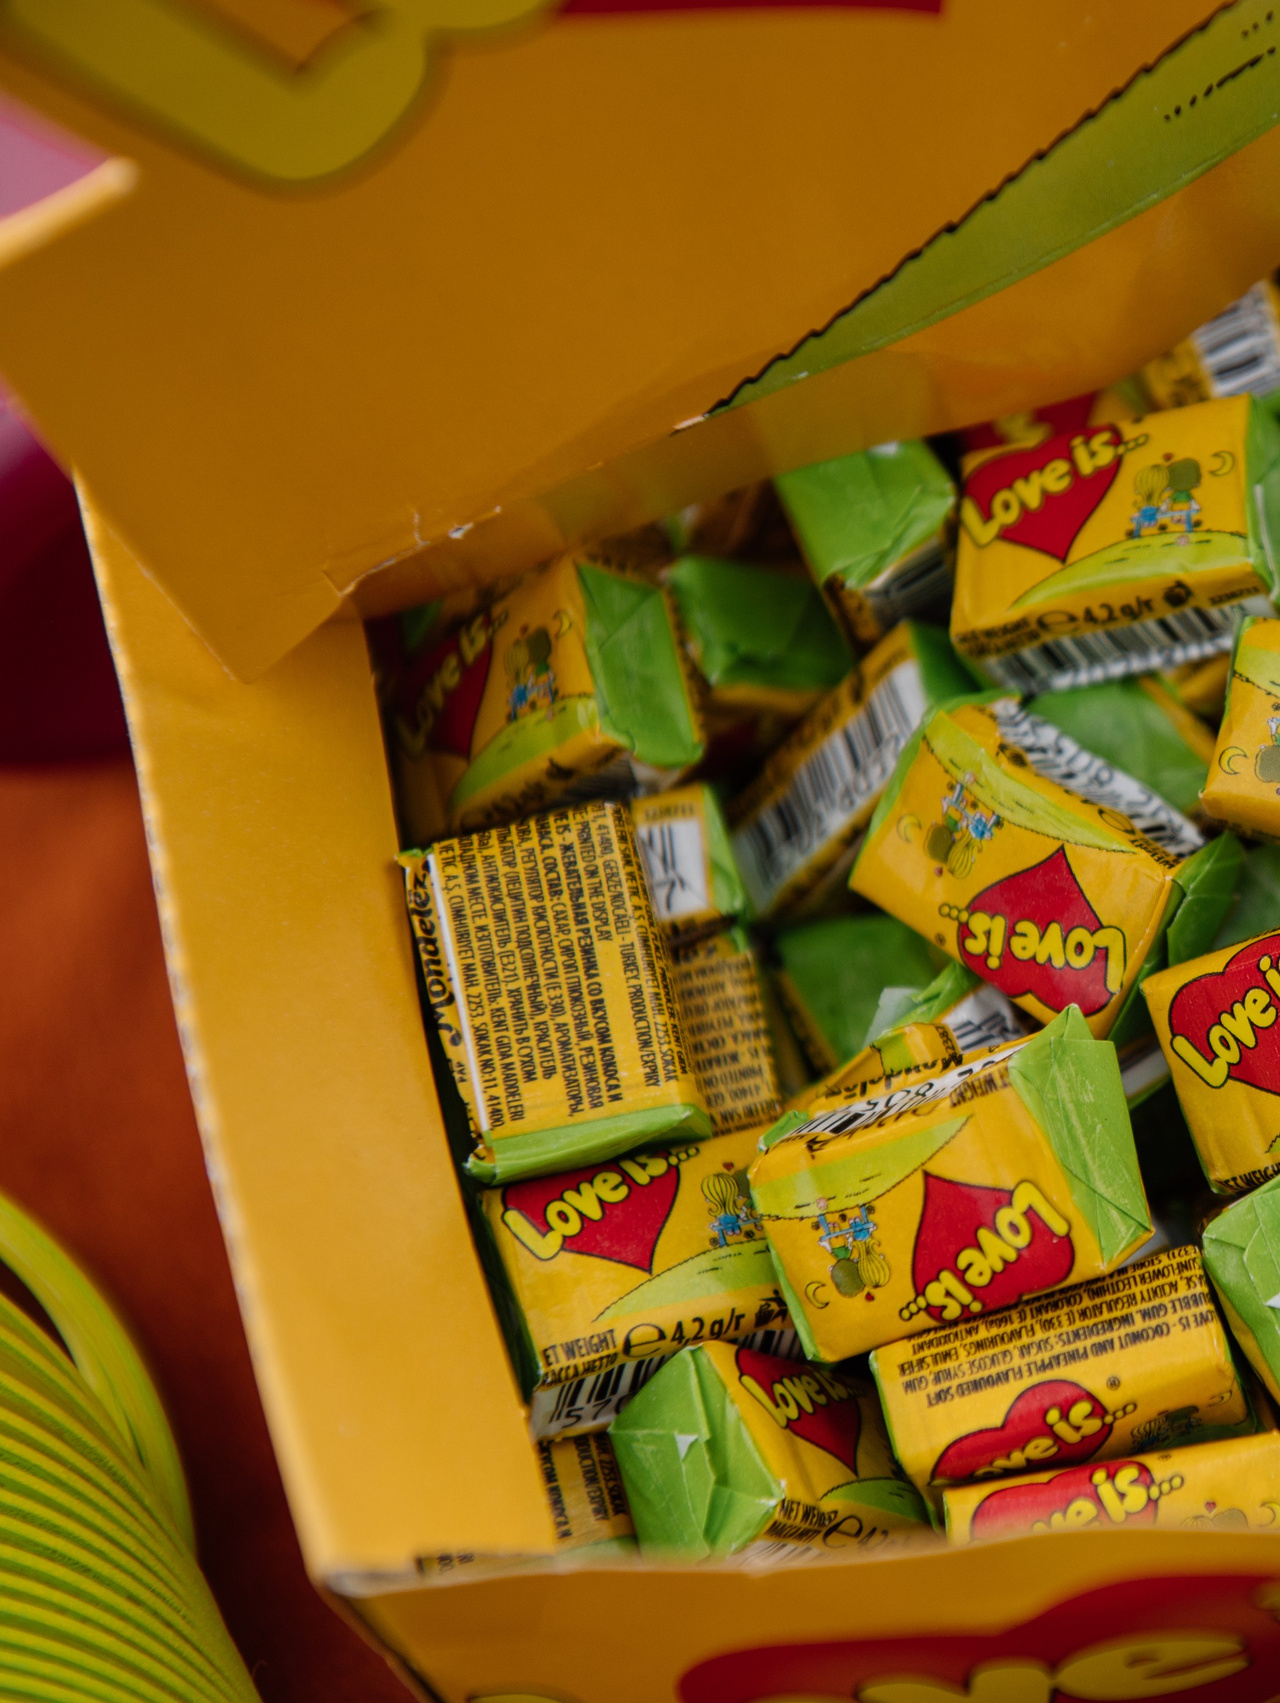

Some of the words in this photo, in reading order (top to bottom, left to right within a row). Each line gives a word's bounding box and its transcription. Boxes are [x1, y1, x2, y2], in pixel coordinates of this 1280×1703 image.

[961, 457, 1072, 550] Love
[577, 820, 596, 863] PRINTED
[521, 848, 544, 903] РЕГУЛЯТОР
[542, 856, 563, 901] СОСТАВ:
[560, 843, 589, 926] ЖЕВАТЕЛЬНАЯ
[584, 864, 600, 880] ON
[588, 879, 605, 900] THE
[467, 886, 487, 923] МЕСТЕ.
[482, 855, 511, 948] АНТИОКИСЛИТЕЛЬ
[450, 895, 474, 960] CUMHURIYET
[551, 902, 571, 938] САХАР,
[591, 901, 612, 941] DISPLAY
[532, 905, 559, 980] КИСЛОТНОСТИ
[558, 938, 579, 975] СИРОП
[577, 927, 599, 980] РЕЗИНКА
[1009, 918, 1128, 996] Love
[462, 962, 479, 991] MAH.
[475, 925, 502, 1004] ИЗГОТОВИТЕЛЬ:
[504, 871, 527, 924] (ЛЕЦИТИН
[516, 925, 545, 1019] ПОДСОЛНЕЧНЫЙ),
[534, 1021, 557, 1080] КРАСИТЕЛЬ
[620, 942, 640, 983] TURKEY.
[638, 925, 659, 989] CUMHURIYET
[651, 991, 665, 1016] MAH.
[466, 992, 485, 1021] 2253.
[586, 981, 603, 997] СО
[490, 1007, 509, 1033] KENT
[507, 987, 528, 1036] ХРАНИТЬ
[566, 975, 591, 1045] ГЛЮКОЗНЫЙ,
[590, 998, 612, 1045] ВКУСОМ
[472, 1022, 492, 1058] SOKAK
[495, 1035, 513, 1061] GIDA
[515, 1036, 531, 1045] В
[629, 984, 660, 1087] PRODUCTION/EXPIRY
[1170, 986, 1279, 1089] Love
[518, 1045, 538, 1083] СУХОМ
[555, 1023, 583, 1116] АРОМАТИЗАТОРЫ,
[579, 1046, 604, 1109] РЕЗИНОВАЯ
[599, 1046, 620, 1092] КОКОСА
[501, 1062, 524, 1121] MADDELERI
[608, 1092, 623, 1103] И
[487, 1095, 505, 1131] 41400,
[501, 1165, 628, 1261] Love
[954, 1178, 1072, 1286] Love
[1030, 1292, 1083, 1318] COLORANT
[1083, 1275, 1138, 1301] LECITHIN),
[1140, 1280, 1178, 1303] ACIDITY
[1077, 1293, 1137, 1321] REGULATOR
[1136, 1303, 1168, 1322] GUM.
[1178, 1316, 1191, 1331] IS
[564, 1328, 617, 1360] WEIGHT
[670, 1314, 708, 1351] 4,2
[912, 1324, 979, 1355] ANTIOXIDANT
[963, 1324, 1035, 1355] FLAVOURINGS,
[1017, 1336, 1054, 1358] SUGAR,
[1058, 1313, 1135, 1345] INGREDIENTS:
[1090, 1338, 1115, 1356] AND
[1118, 1322, 1170, 1349] COCONUT
[898, 1347, 959, 1376] EMULSIFIER
[930, 1363, 965, 1385] SYRUP,
[968, 1349, 1013, 1374] GLUCOSE
[1027, 1347, 1088, 1376] PINEAPPLE
[739, 1368, 826, 1430] Love
[904, 1375, 928, 1393] GUM
[927, 1386, 955, 1407] SOFT
[956, 1367, 1023, 1396] FLAVOURED
